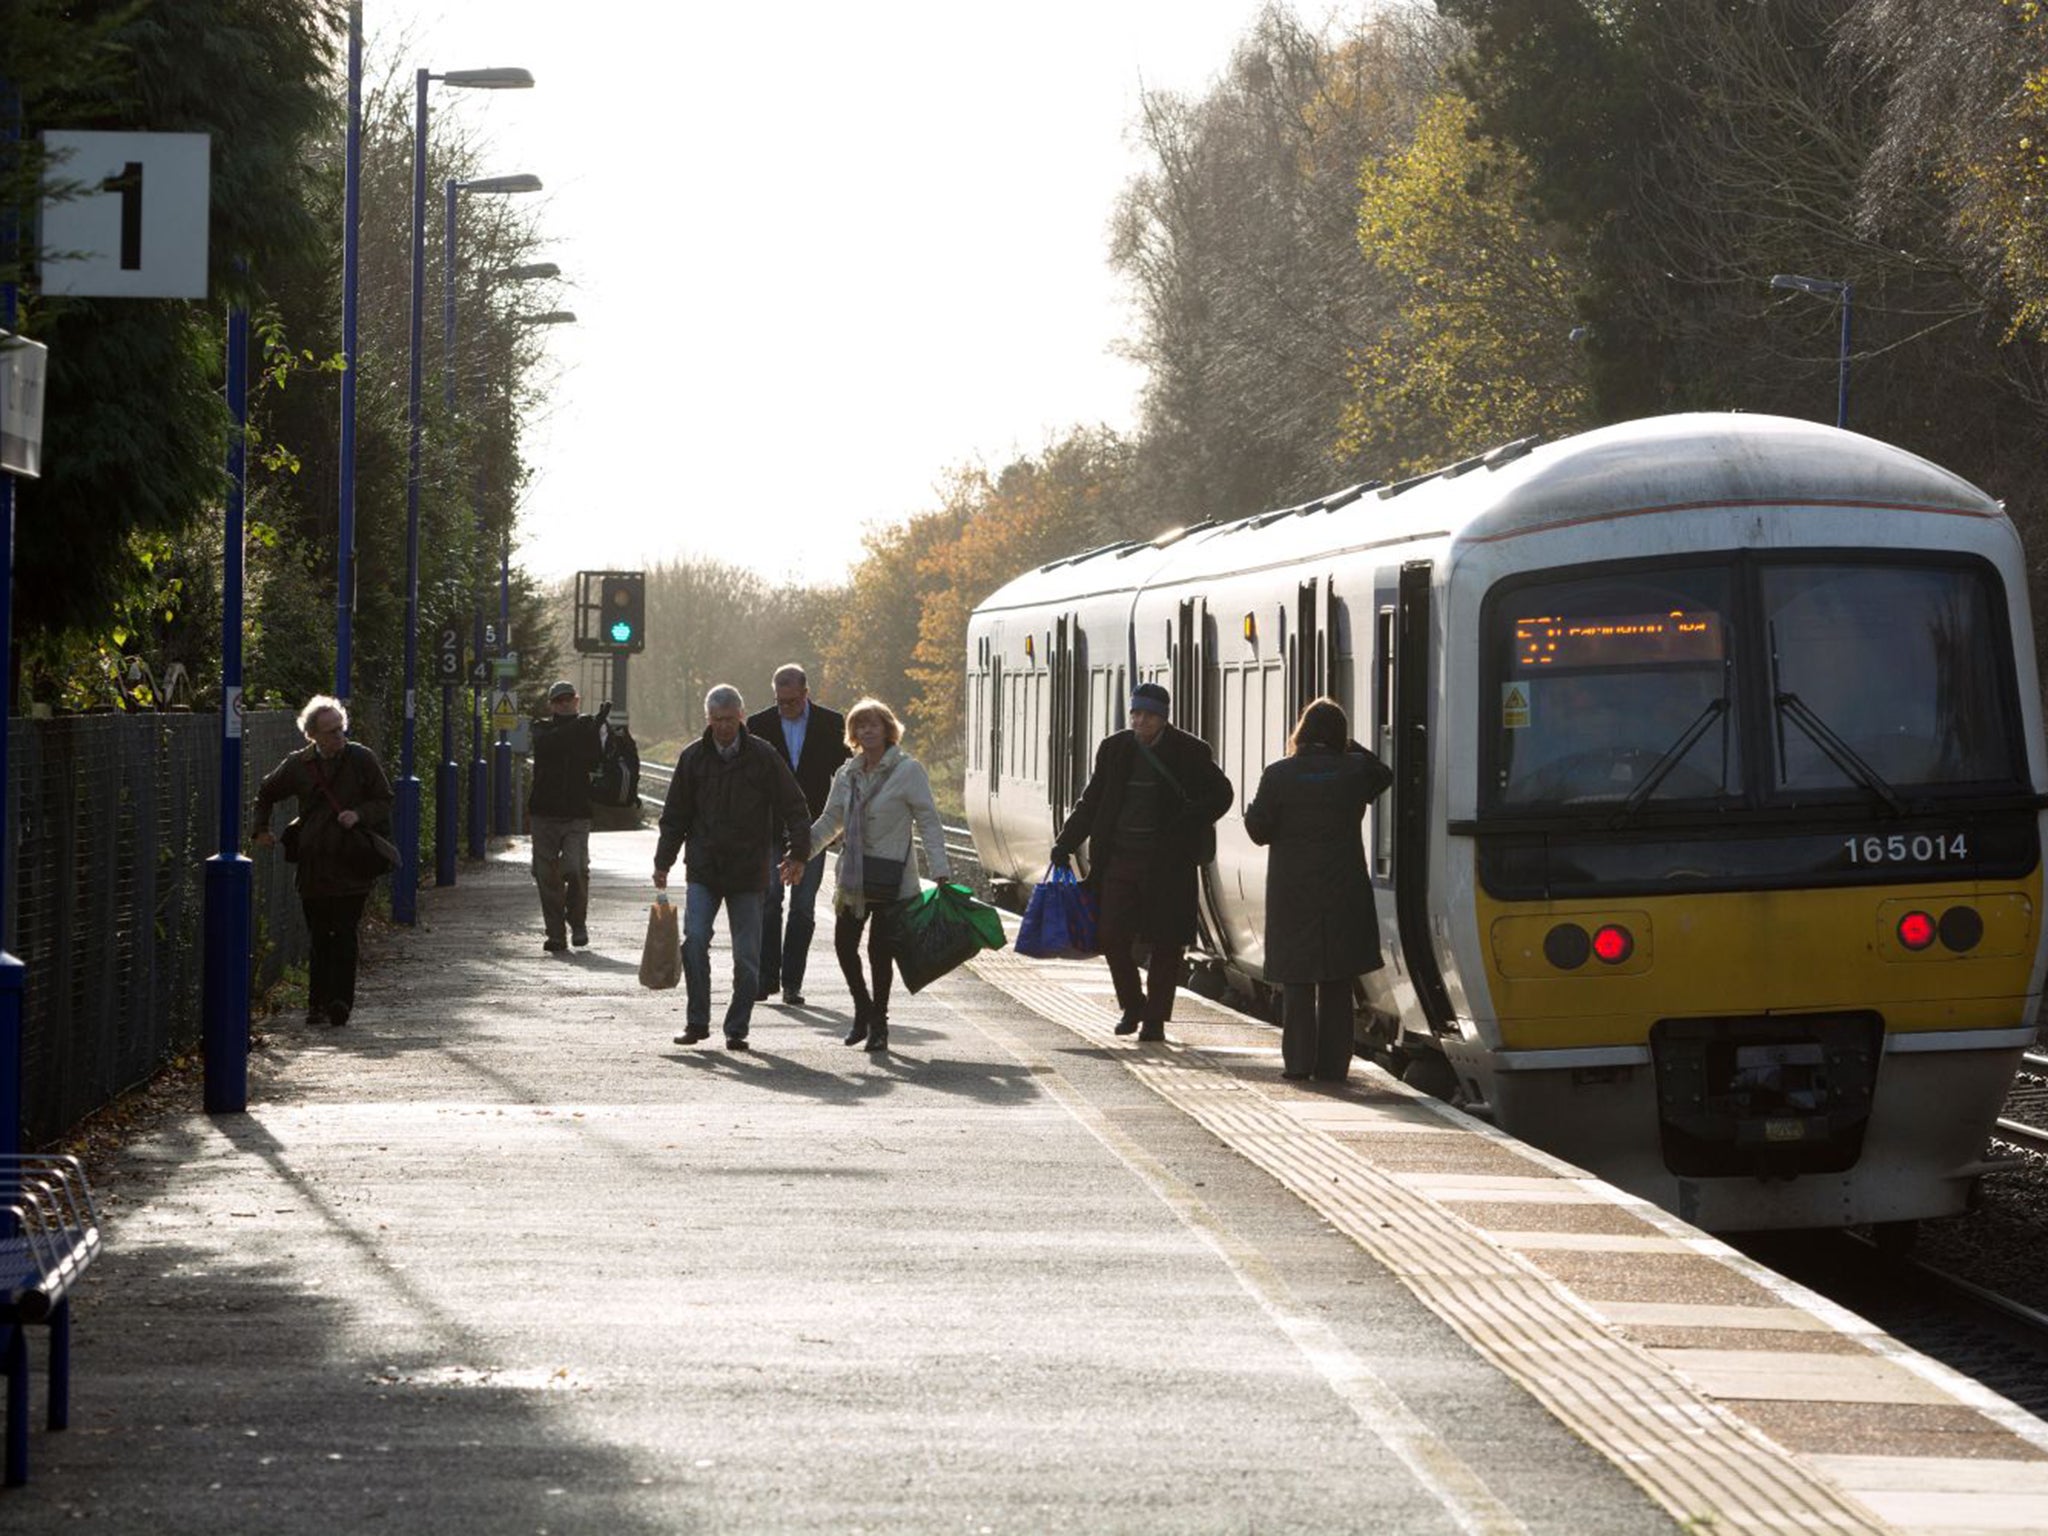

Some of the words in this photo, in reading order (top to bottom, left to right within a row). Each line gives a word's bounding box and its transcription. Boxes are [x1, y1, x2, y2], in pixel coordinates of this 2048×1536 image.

[103, 161, 143, 271] 1
[443, 629, 457, 649] 2
[486, 627, 496, 643] 5
[443, 653, 457, 673] 3
[474, 663, 487, 679] 4
[1844, 833, 1968, 863] 165014
